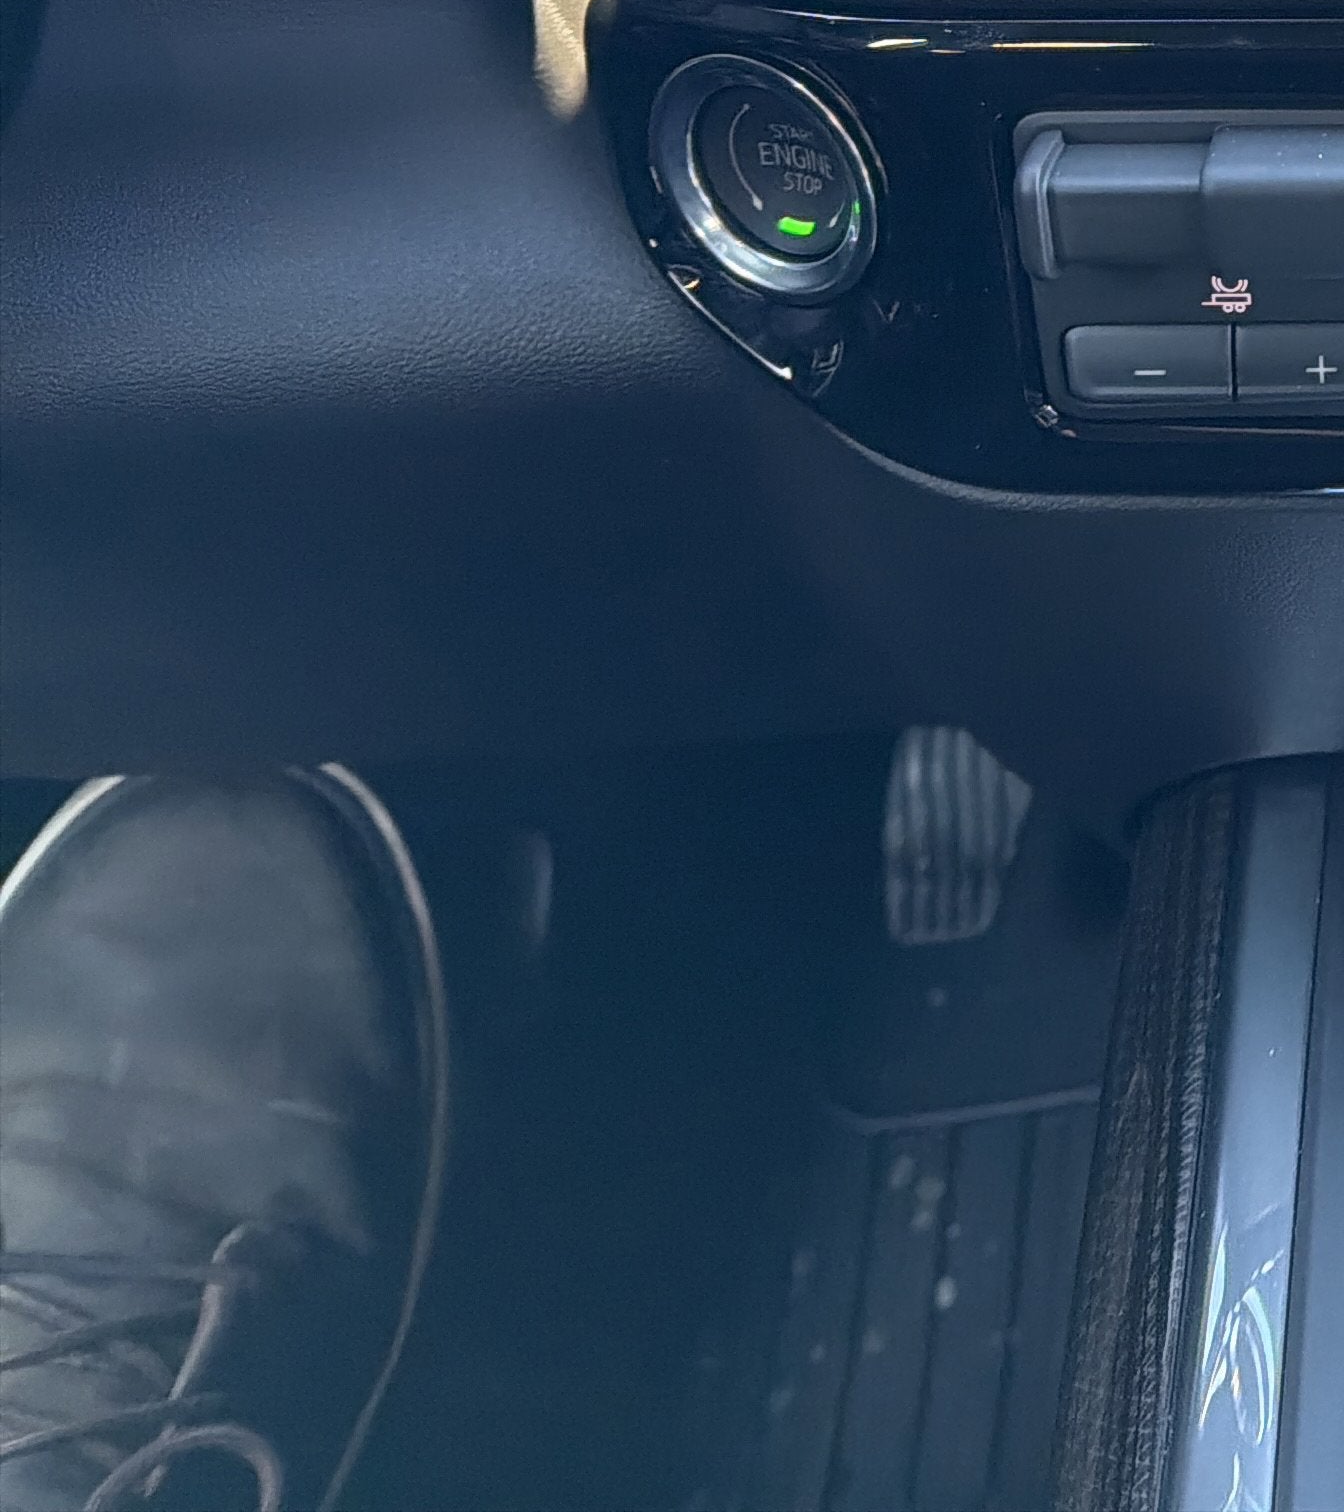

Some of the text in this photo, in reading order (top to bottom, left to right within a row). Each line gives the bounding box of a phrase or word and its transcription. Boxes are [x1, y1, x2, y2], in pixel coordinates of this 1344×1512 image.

[768, 123, 814, 142] STA
[758, 141, 835, 180] ENGINE
[783, 171, 822, 195] STOP
